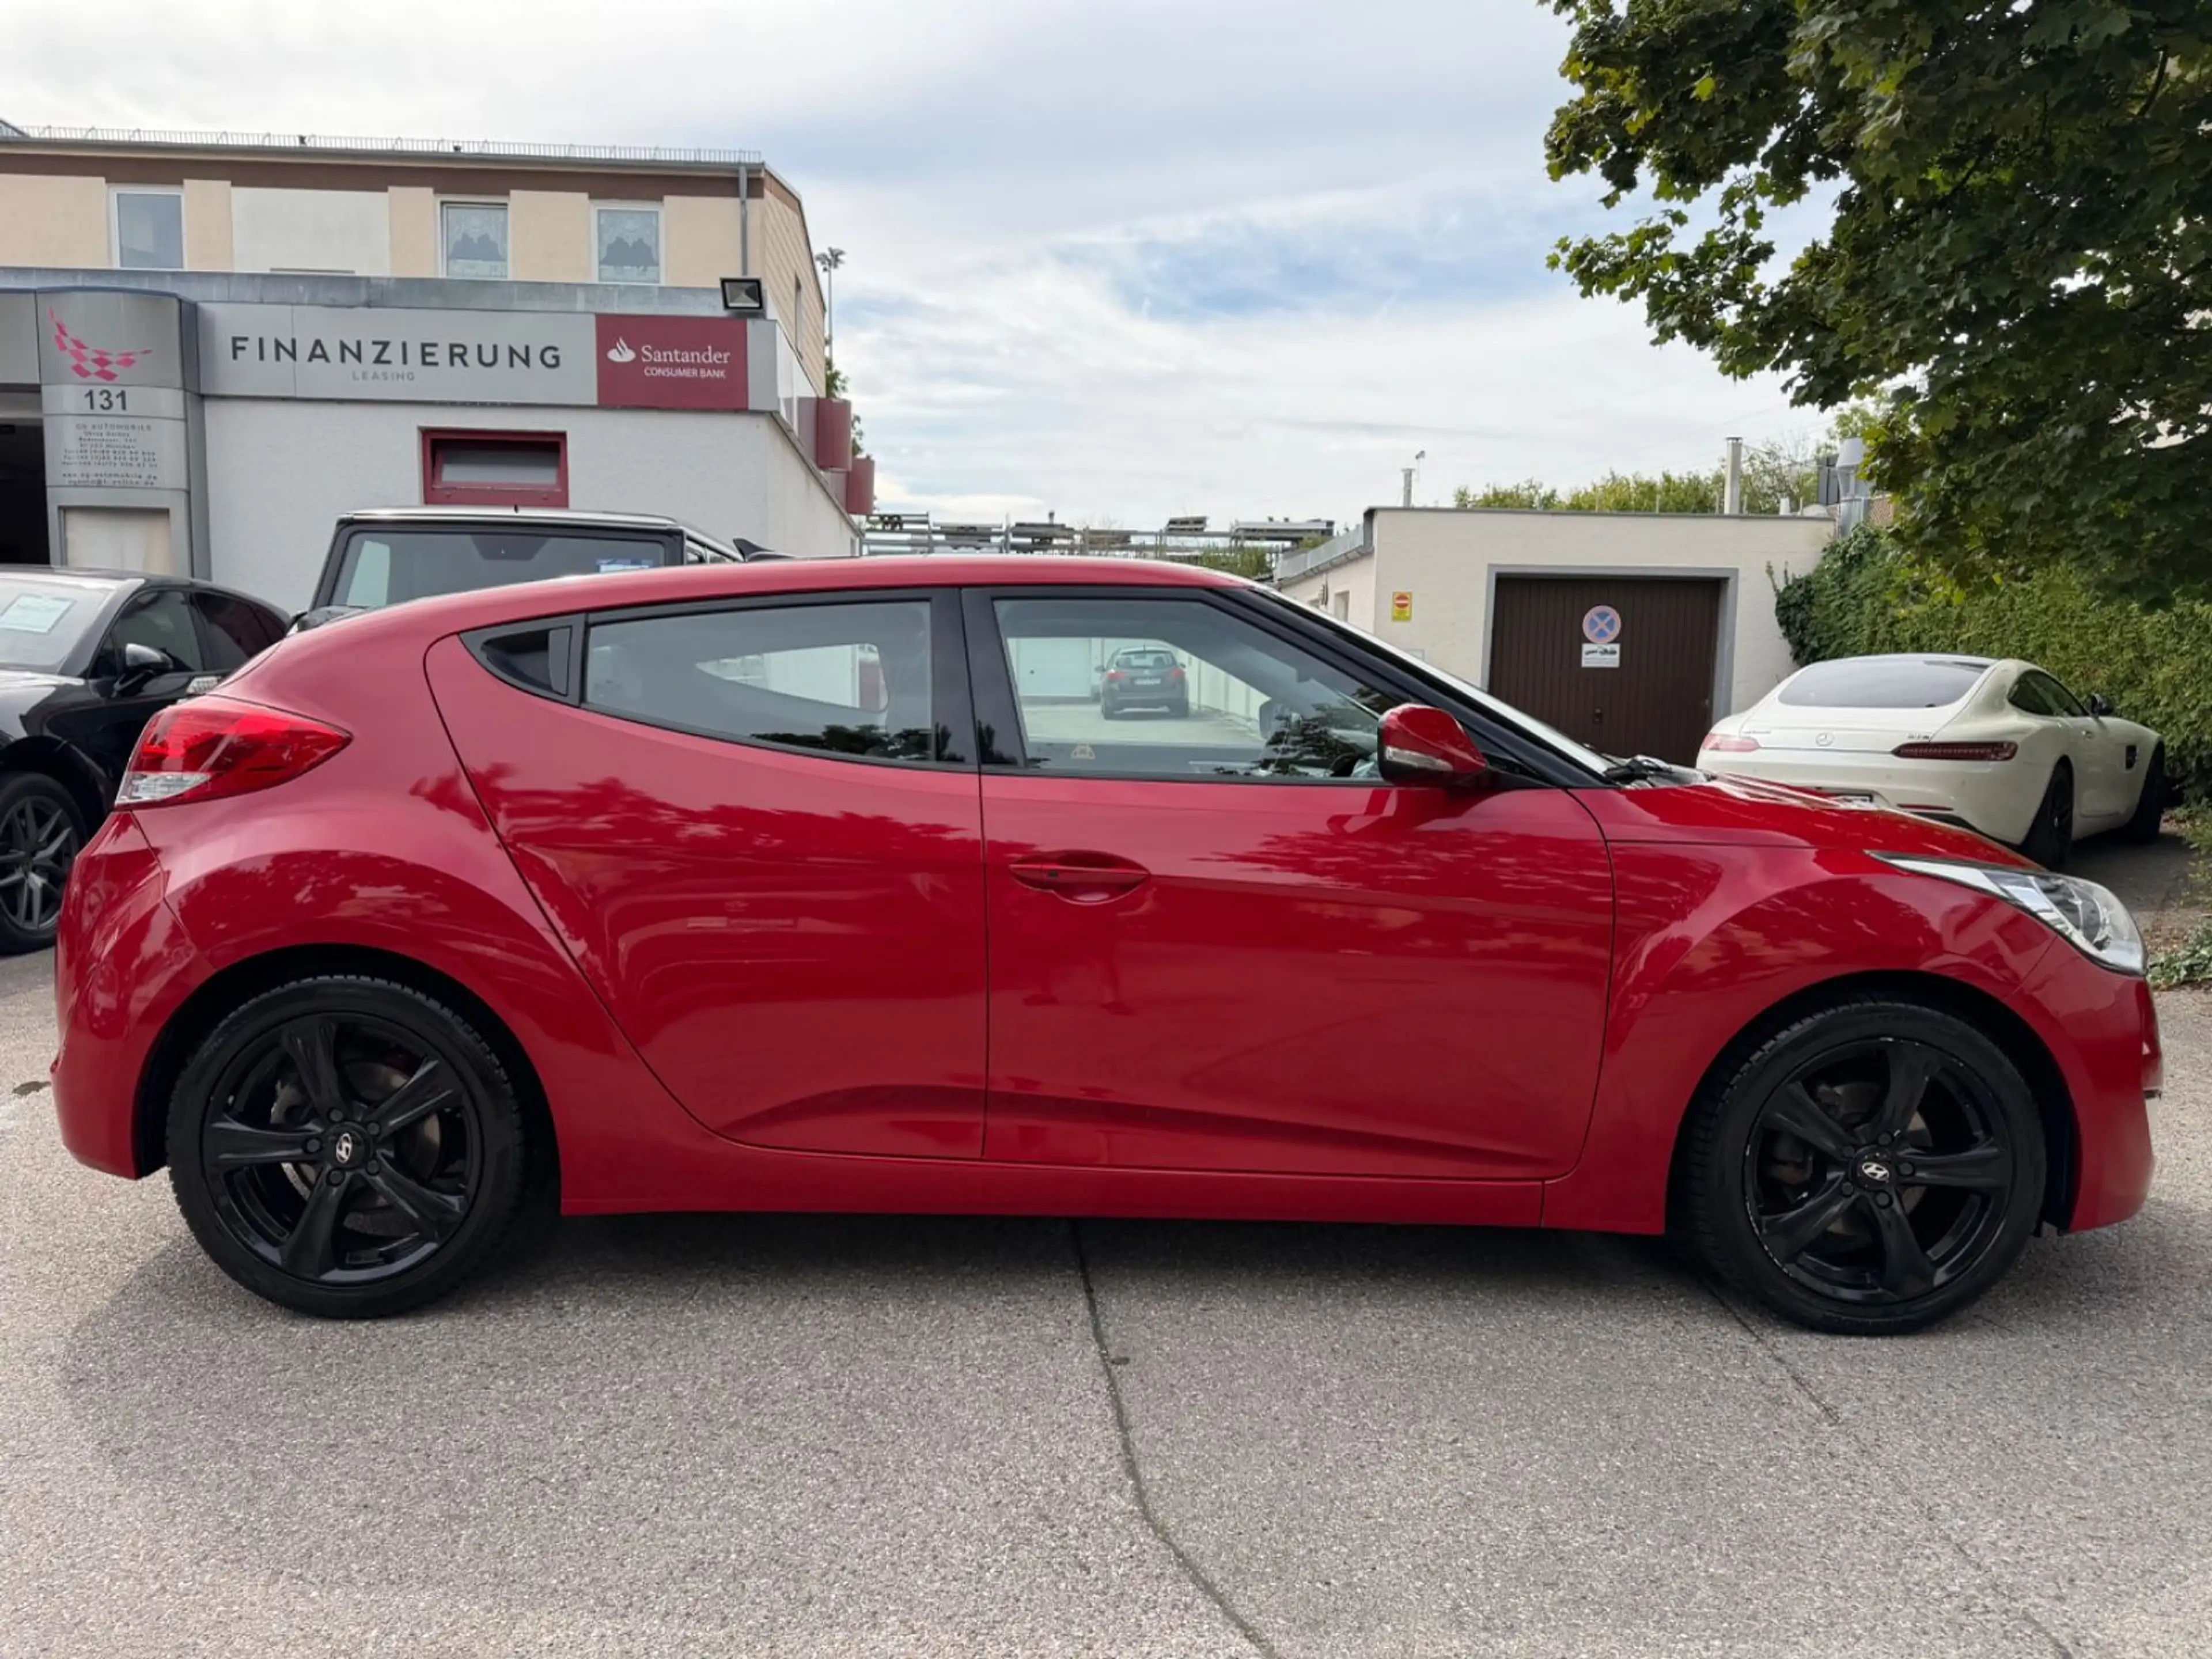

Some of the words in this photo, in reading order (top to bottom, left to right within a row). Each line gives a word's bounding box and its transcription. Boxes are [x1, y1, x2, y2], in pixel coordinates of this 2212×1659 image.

[232, 336, 561, 369] FINANZIERUNG
[641, 344, 730, 363] Santander
[352, 370, 415, 381] LEASING
[644, 367, 698, 378] CONSUMER
[699, 369, 726, 379] BANK
[84, 389, 127, 411] 131
